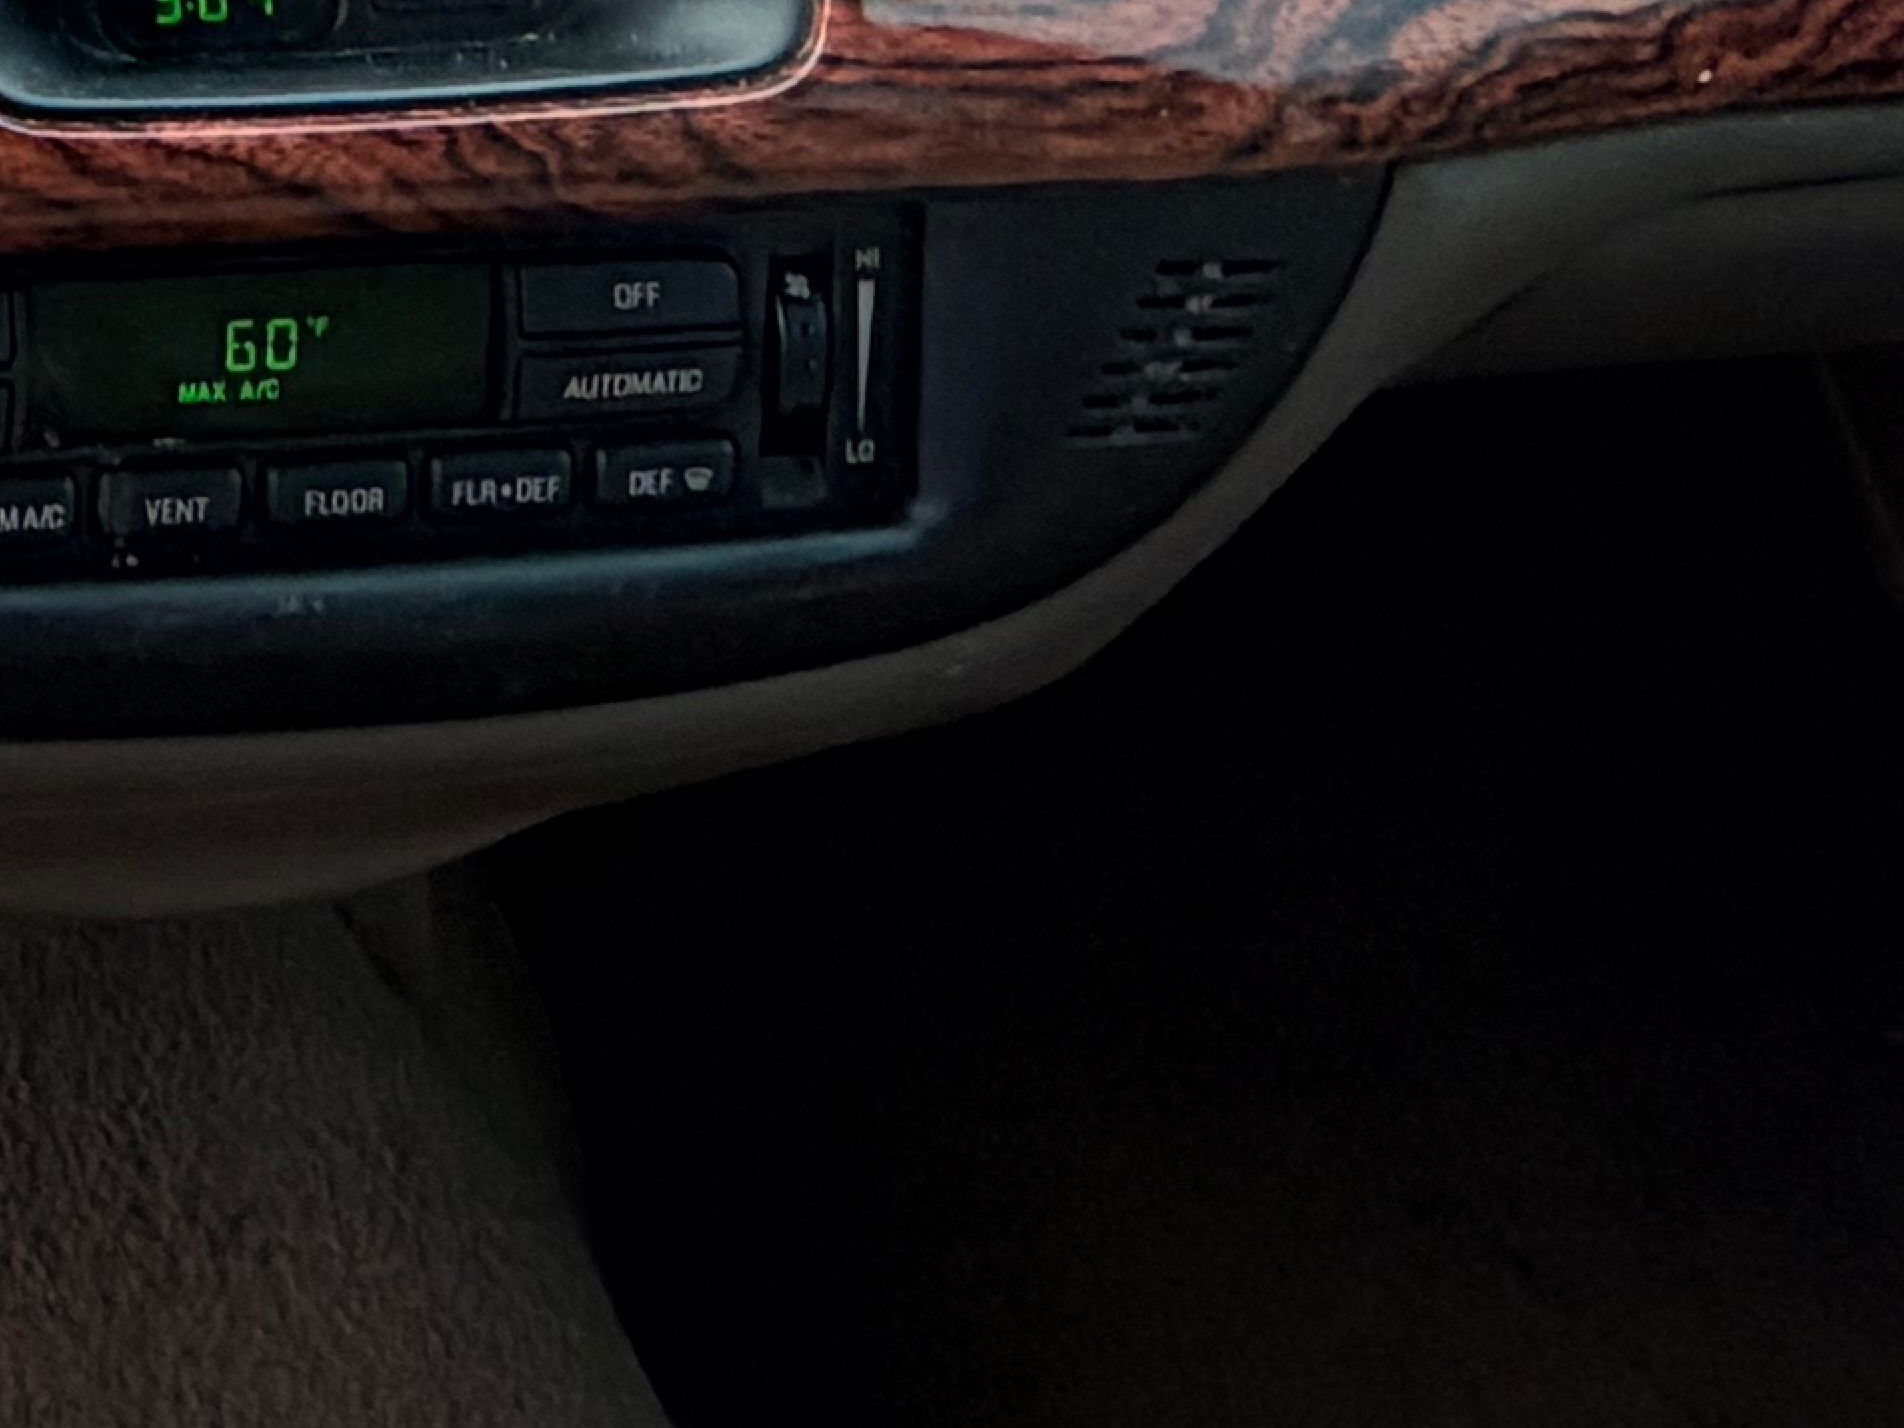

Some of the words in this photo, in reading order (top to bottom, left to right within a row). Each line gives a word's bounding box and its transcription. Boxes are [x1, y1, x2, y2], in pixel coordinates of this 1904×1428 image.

[855, 247, 880, 270] HI
[614, 281, 660, 310] OFF
[179, 382, 226, 403] MAX
[240, 378, 280, 399] A/C
[564, 370, 703, 400] AUTOMATIC
[845, 439, 875, 464] LO
[628, 467, 673, 497] DEF
[145, 497, 208, 526] VENT
[305, 486, 384, 516] FLOOR
[23, 504, 65, 531] A/C
